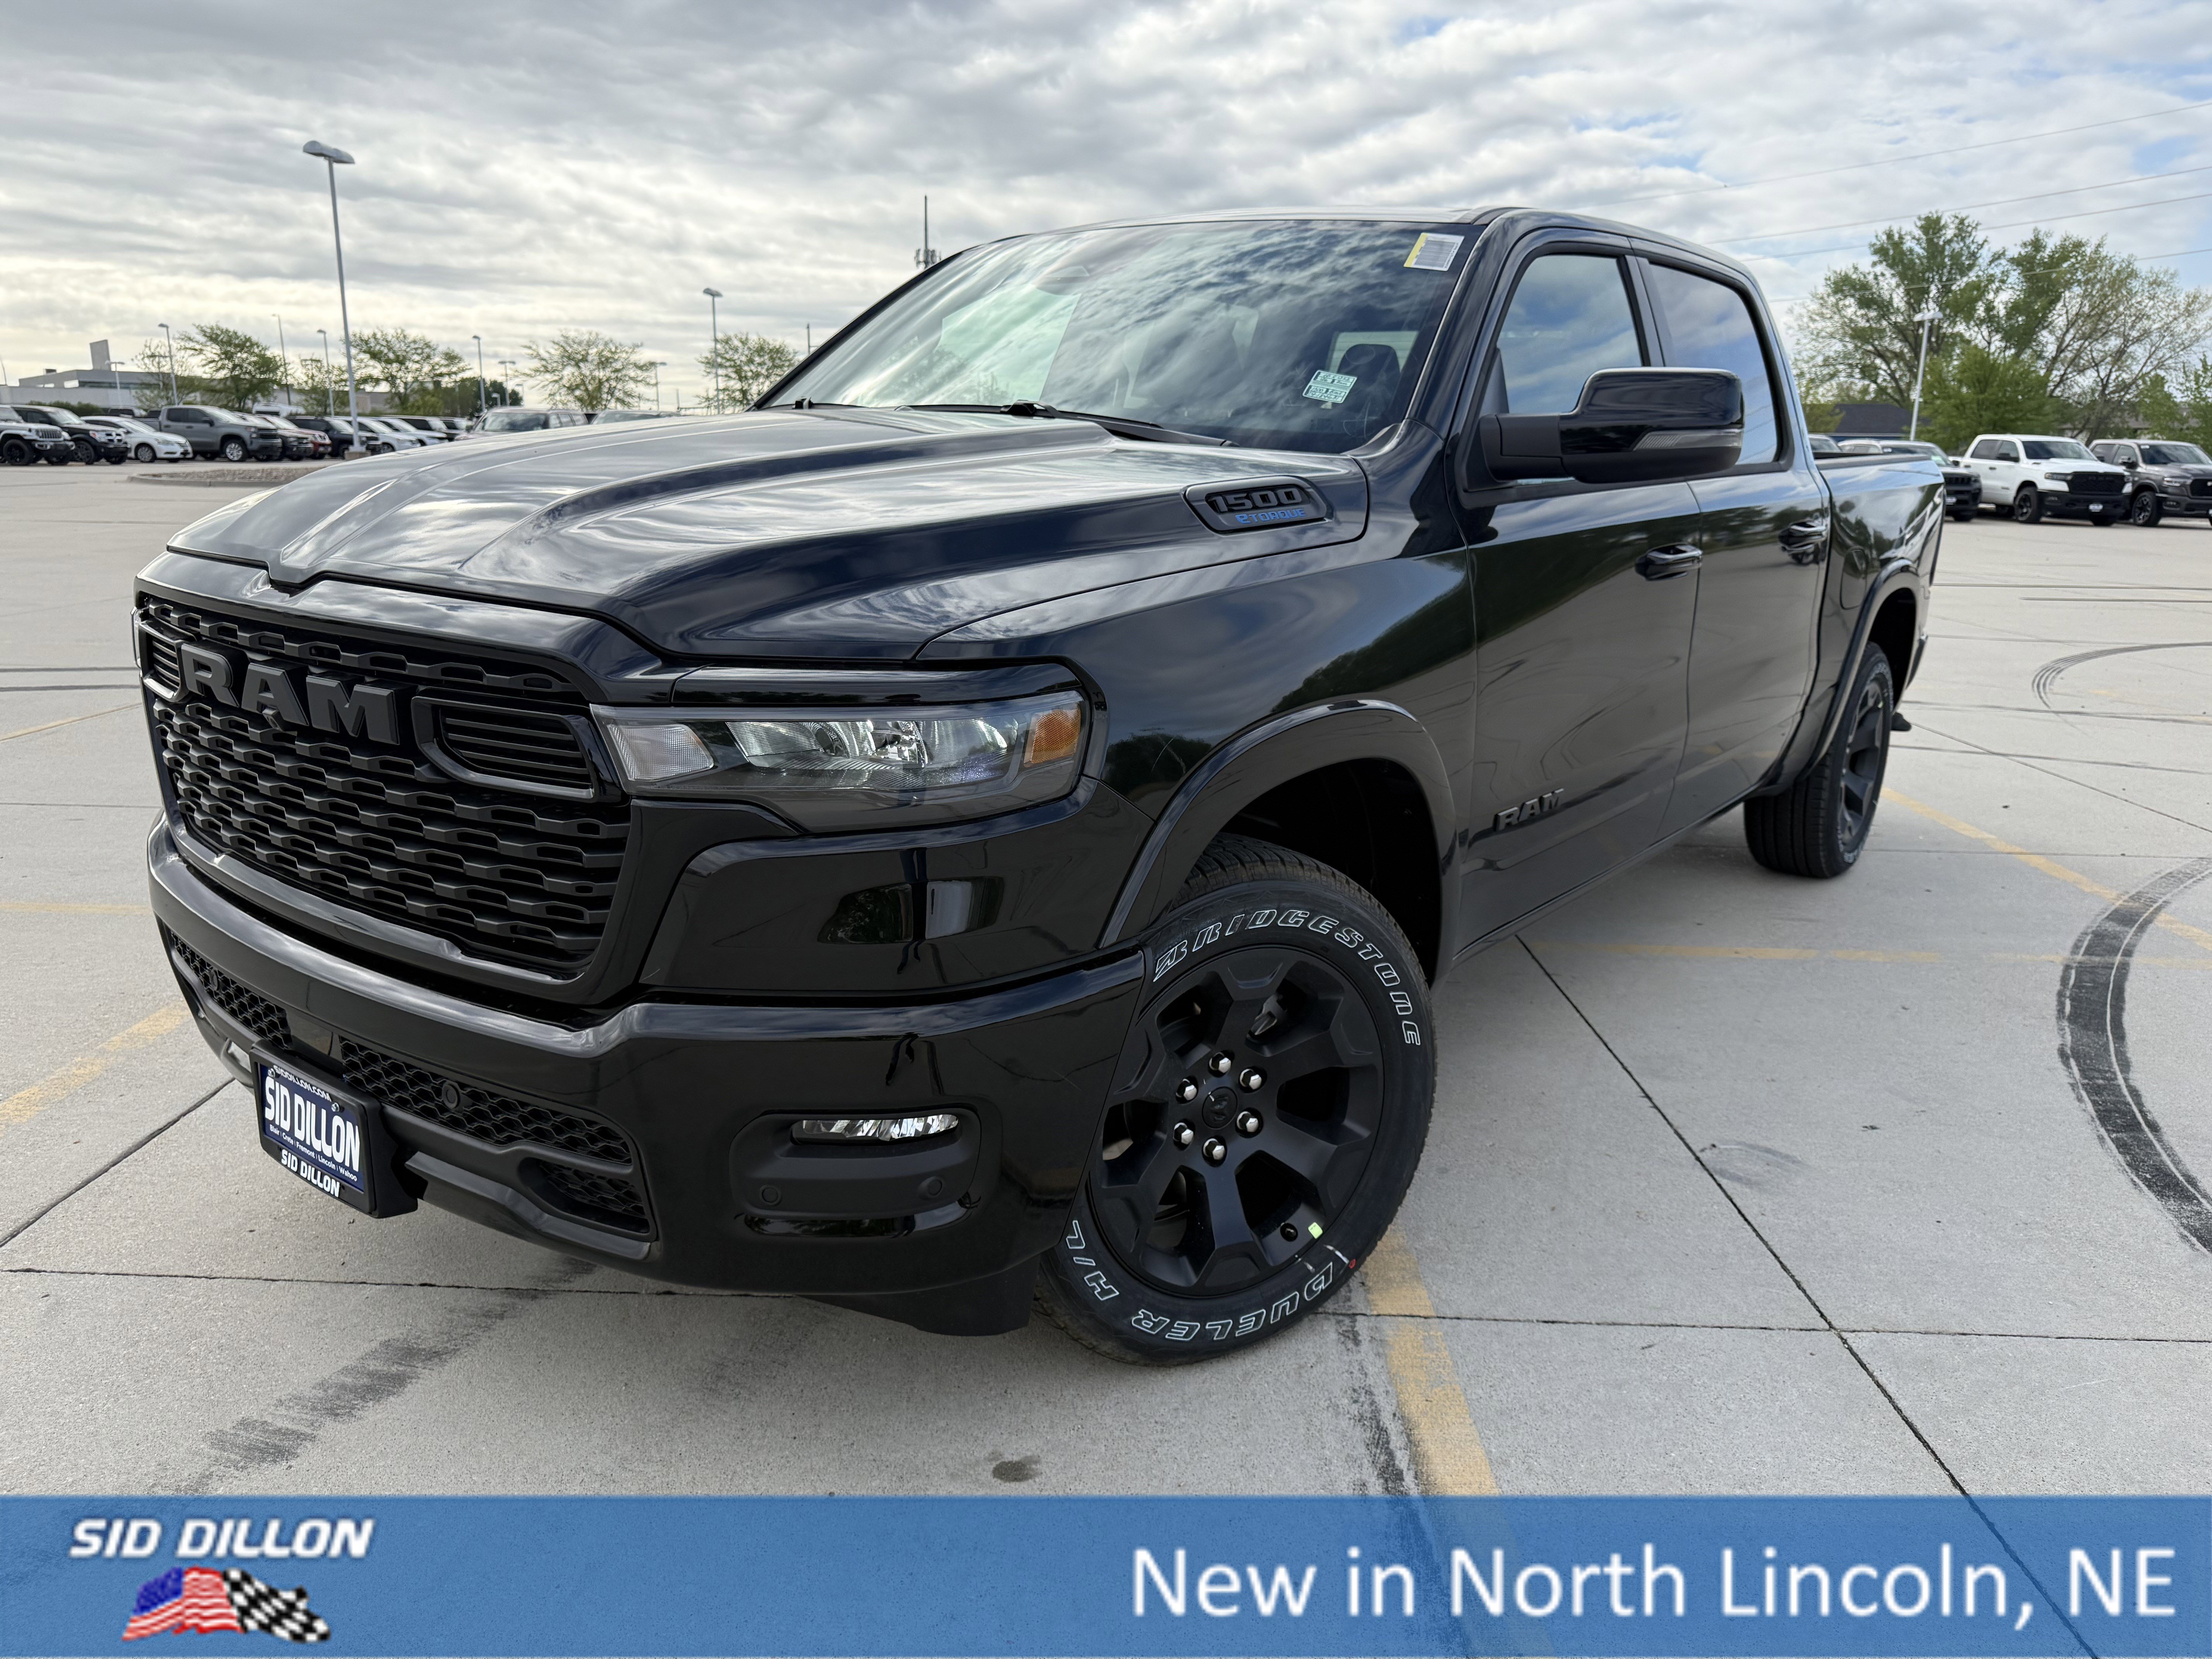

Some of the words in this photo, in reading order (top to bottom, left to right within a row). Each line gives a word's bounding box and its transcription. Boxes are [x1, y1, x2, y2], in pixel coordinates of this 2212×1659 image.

[1208, 488, 1302, 513] 1500
[180, 641, 400, 746] RAM
[1492, 788, 1565, 831] RAM
[1153, 909, 1421, 1046] BRIDGESTONE
[273, 1065, 332, 1102] SIDDILLON.COM
[265, 1076, 291, 1132] SID
[294, 1093, 361, 1172] DILLON
[270, 1124, 280, 1135] Blair
[282, 1132, 294, 1146] Crete
[296, 1142, 315, 1159] Fremont
[318, 1156, 336, 1170] Lincoln
[339, 1166, 357, 1182] Wahoo
[281, 1149, 298, 1172] SID
[300, 1159, 340, 1198] DILLON
[1066, 1220, 1120, 1301] H/L
[1132, 1262, 1333, 1342] DUELER
